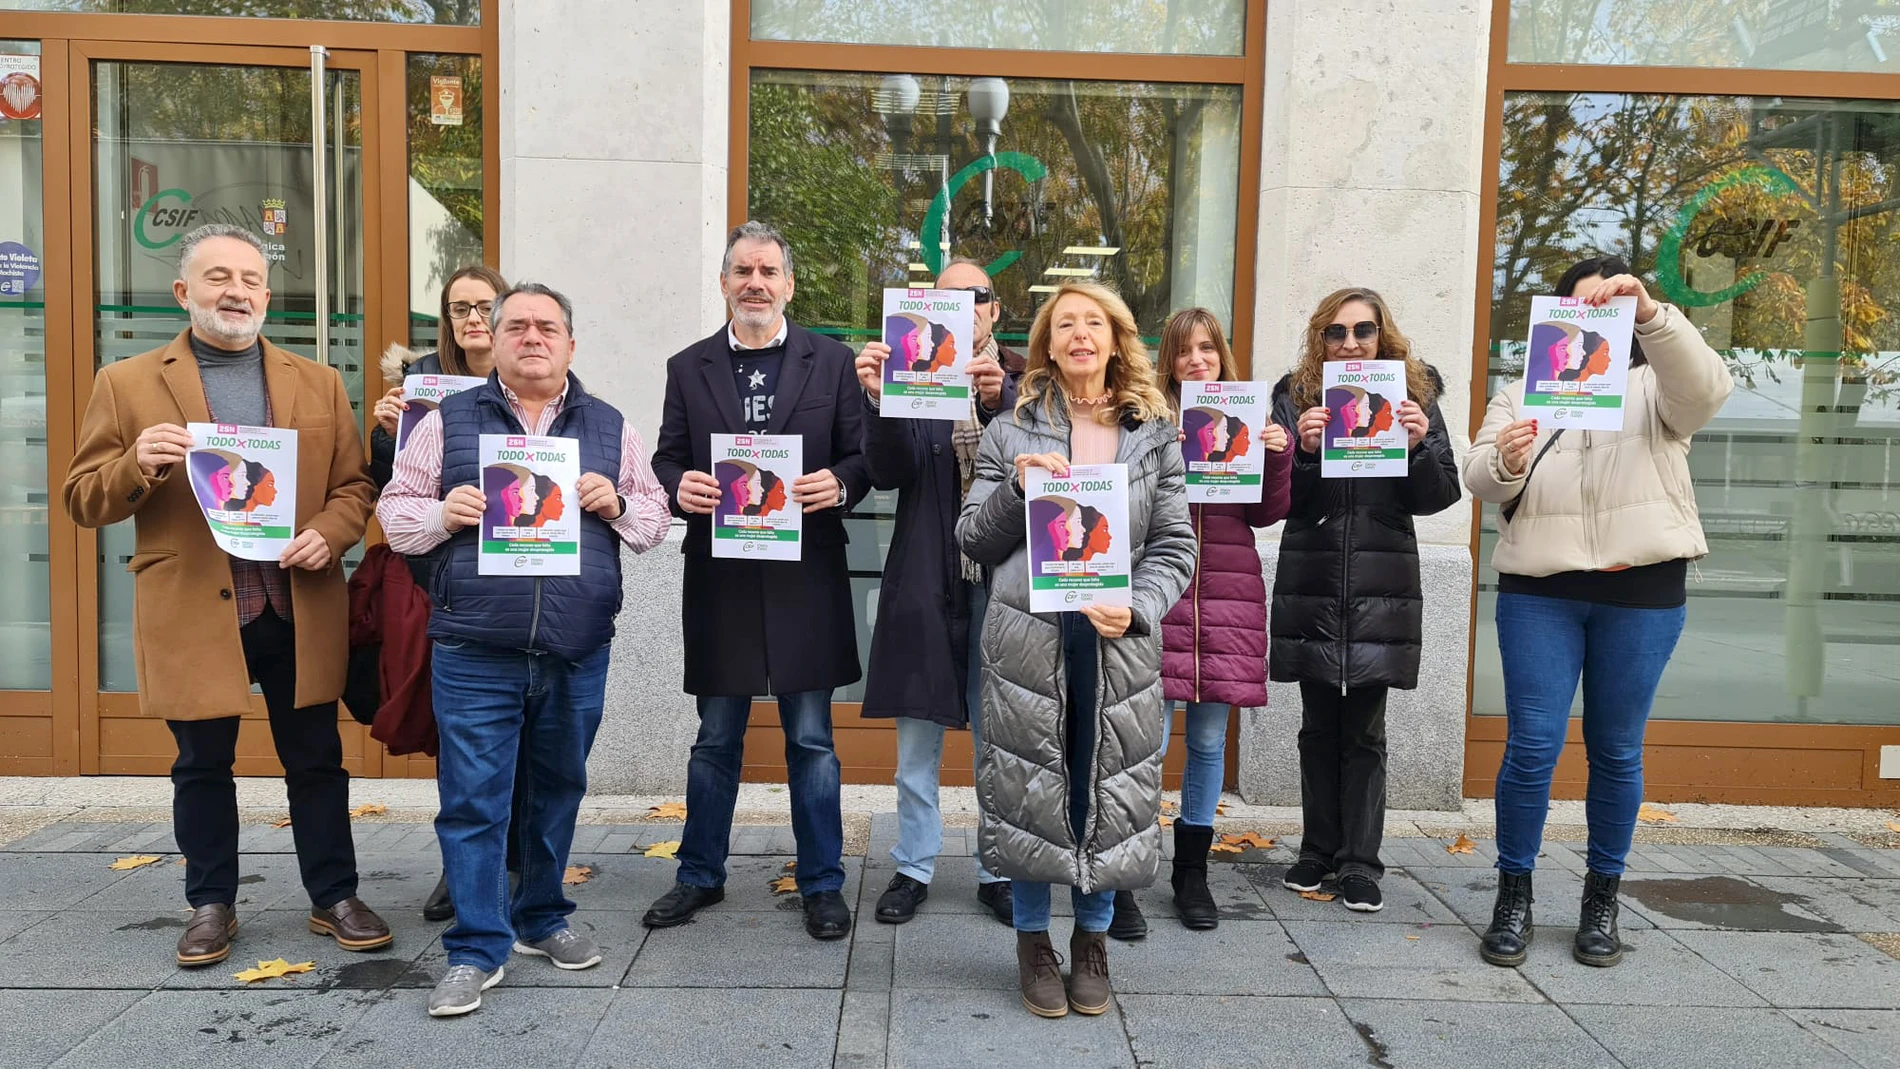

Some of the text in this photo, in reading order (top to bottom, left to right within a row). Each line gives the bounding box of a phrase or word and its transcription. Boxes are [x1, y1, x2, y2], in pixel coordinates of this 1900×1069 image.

[152, 209, 198, 227] CSIF
[9, 253, 38, 263] Violeta
[10, 262, 39, 271] Violencia
[899, 301, 923, 310] TODO
[932, 302, 961, 312] TODAS
[1548, 309, 1577, 318] TODO
[1586, 307, 1619, 318] TODAS
[1337, 374, 1360, 383] TODO
[1369, 373, 1395, 382] TODAS
[414, 388, 436, 397] TODO
[1196, 396, 1219, 404] TODO
[1228, 396, 1256, 404] TODAS
[218, 425, 235, 433] 25N
[206, 436, 236, 447] TODO
[247, 438, 281, 450] TODAS
[497, 450, 524, 460] TODO
[535, 452, 566, 463] TODAS
[727, 448, 751, 457] TODO
[761, 449, 789, 459] TODAS
[1042, 482, 1070, 493] TODO
[1080, 480, 1113, 492] TODAS
